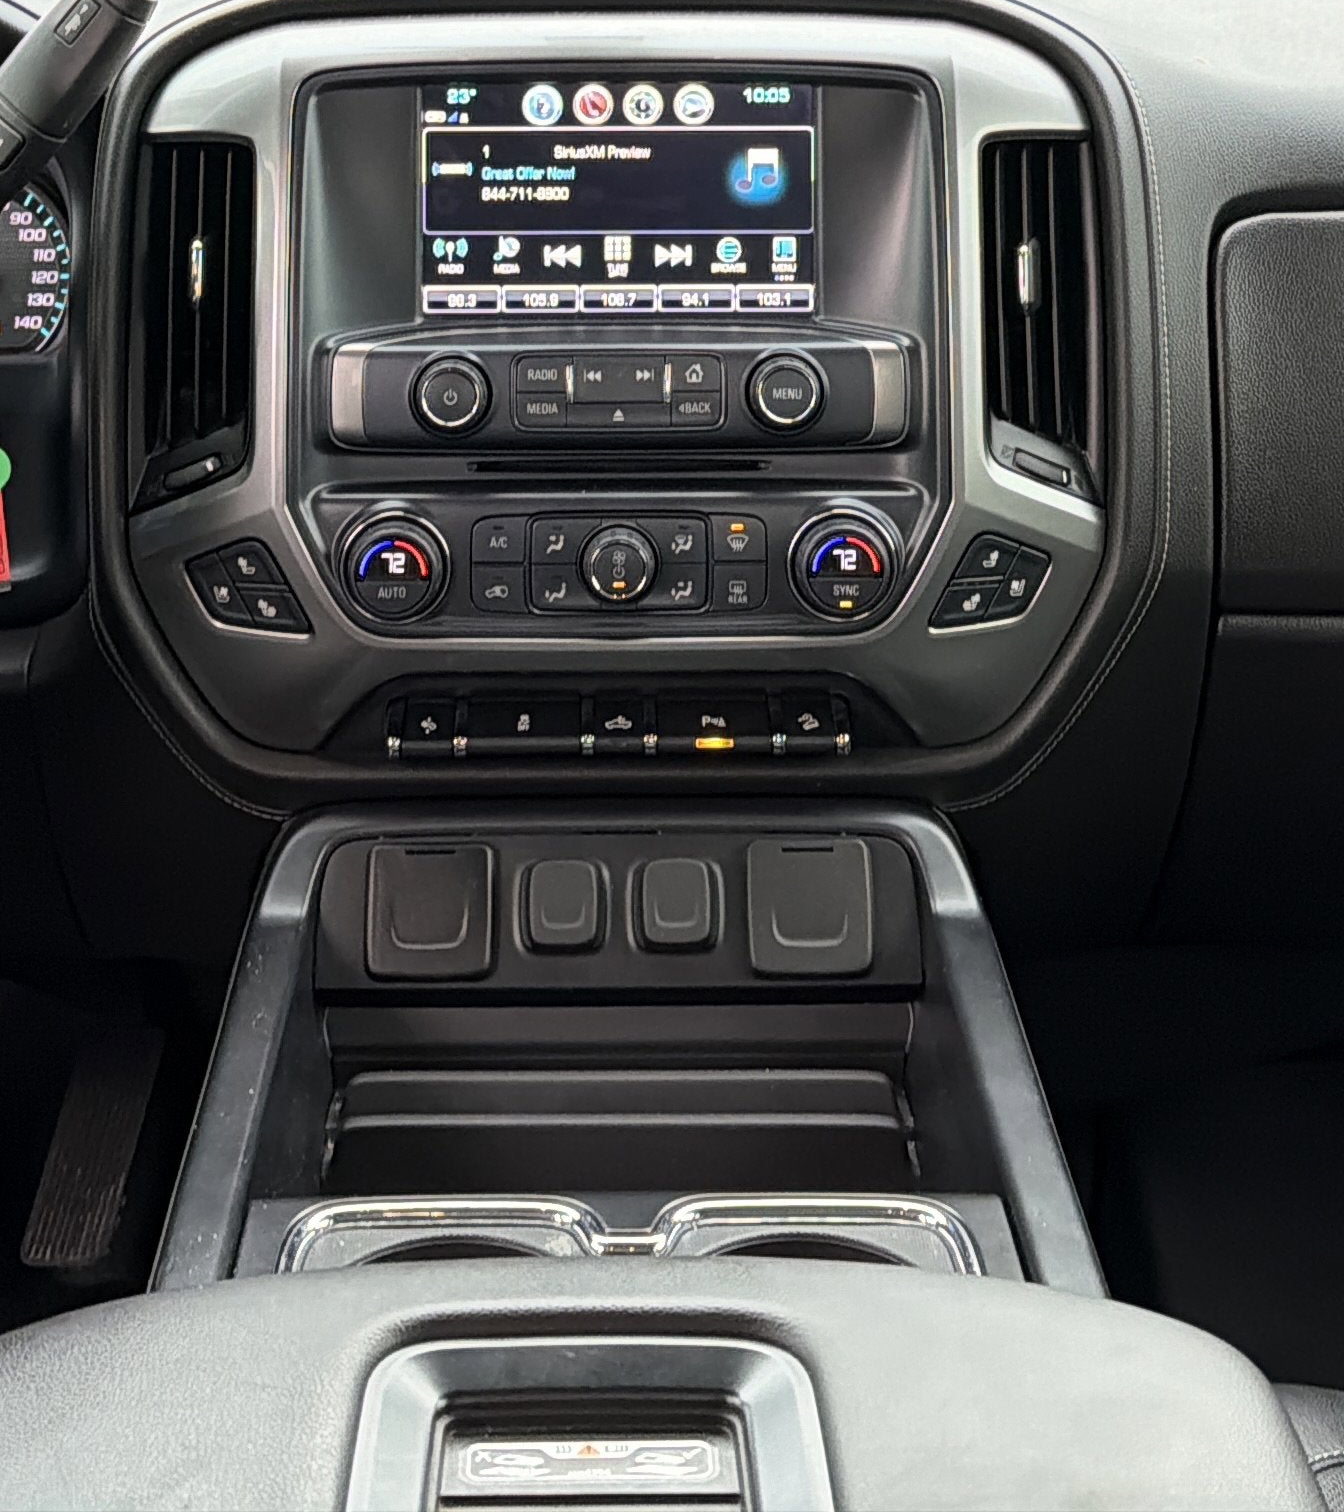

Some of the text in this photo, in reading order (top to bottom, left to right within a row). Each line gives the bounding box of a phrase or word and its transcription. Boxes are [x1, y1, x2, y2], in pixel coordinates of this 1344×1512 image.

[482, 144, 490, 160] 1
[554, 144, 652, 160] SiriusXM Preview
[481, 166, 515, 181] Great
[516, 166, 545, 181] Offer
[9, 211, 33, 226] 90
[18, 228, 47, 242] 100
[33, 248, 56, 262] 110
[31, 270, 59, 285] 120
[27, 292, 55, 307] 130
[681, 292, 710, 307] 94.1
[756, 292, 792, 307] 103.1
[14, 315, 43, 330] 140
[527, 368, 558, 381] RADIO
[772, 388, 803, 400] MENU
[526, 401, 559, 415] MEDIA
[684, 401, 711, 414] BACK
[489, 535, 508, 549] A/C
[381, 552, 406, 575] 72
[832, 549, 857, 571] 72
[377, 586, 406, 600] AUTO
[832, 584, 860, 597] SYNC
[728, 594, 748, 604] REAR
